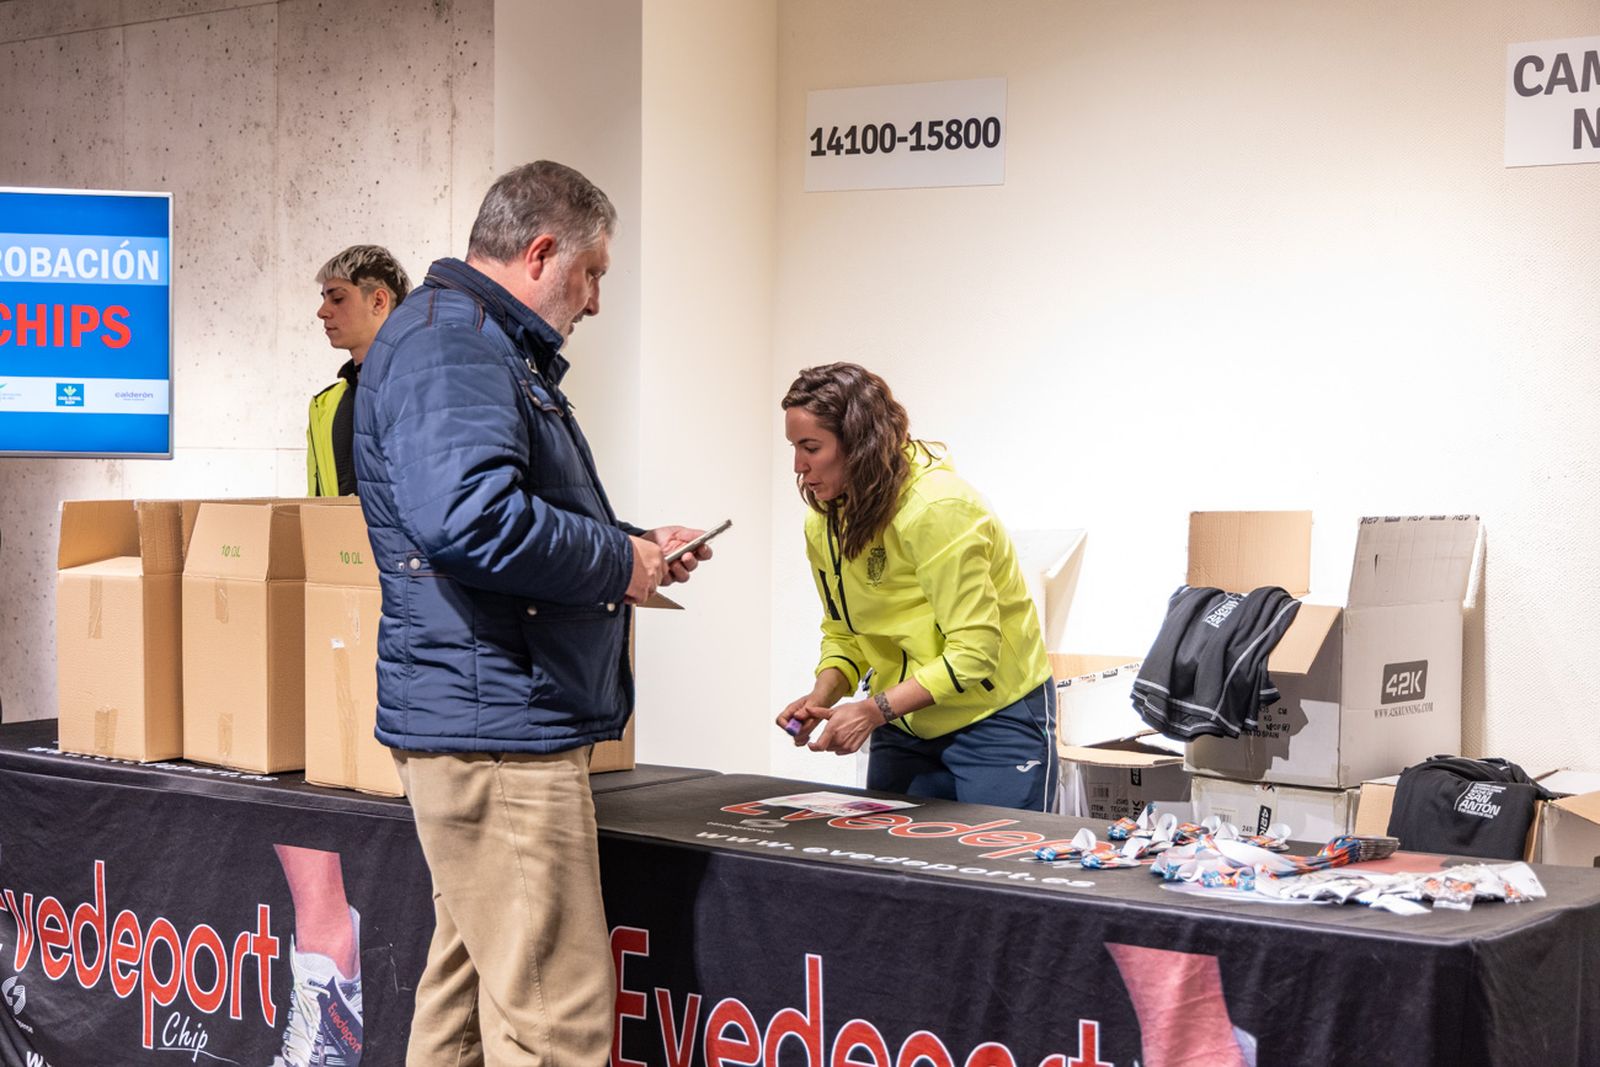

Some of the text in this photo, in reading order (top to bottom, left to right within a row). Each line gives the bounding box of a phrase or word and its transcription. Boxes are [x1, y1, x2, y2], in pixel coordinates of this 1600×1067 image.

[810, 117, 1000, 157] 14100-15800
[0, 239, 159, 281] OBACIÓN
[1385, 669, 1423, 697] 42K
[1458, 799, 1501, 816] ANTÓN
[1465, 792, 1493, 804] SAN
[0, 859, 280, 1050] vedeport
[162, 1011, 209, 1063] Chip
